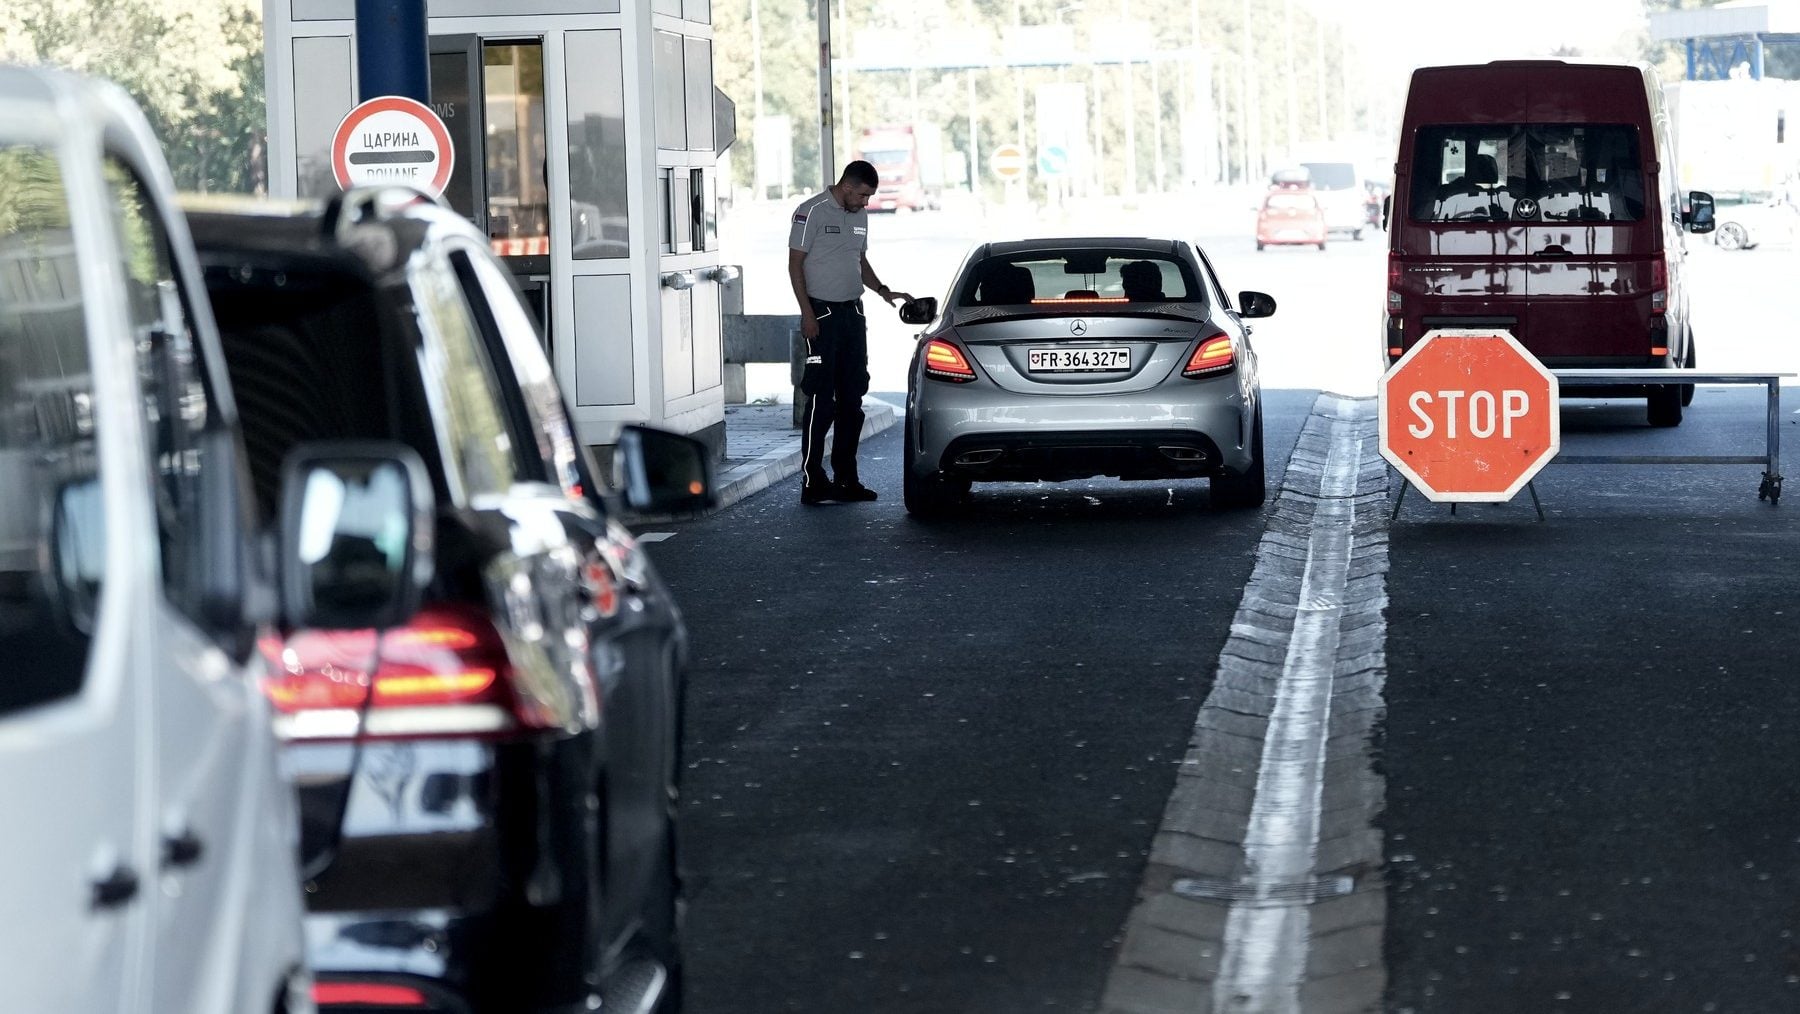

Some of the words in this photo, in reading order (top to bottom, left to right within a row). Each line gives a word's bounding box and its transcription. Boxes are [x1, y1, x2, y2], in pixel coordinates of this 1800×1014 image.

[363, 132, 420, 149] ЦАРИНА
[1092, 351, 1118, 366] 327
[1408, 390, 1530, 439] STOP
